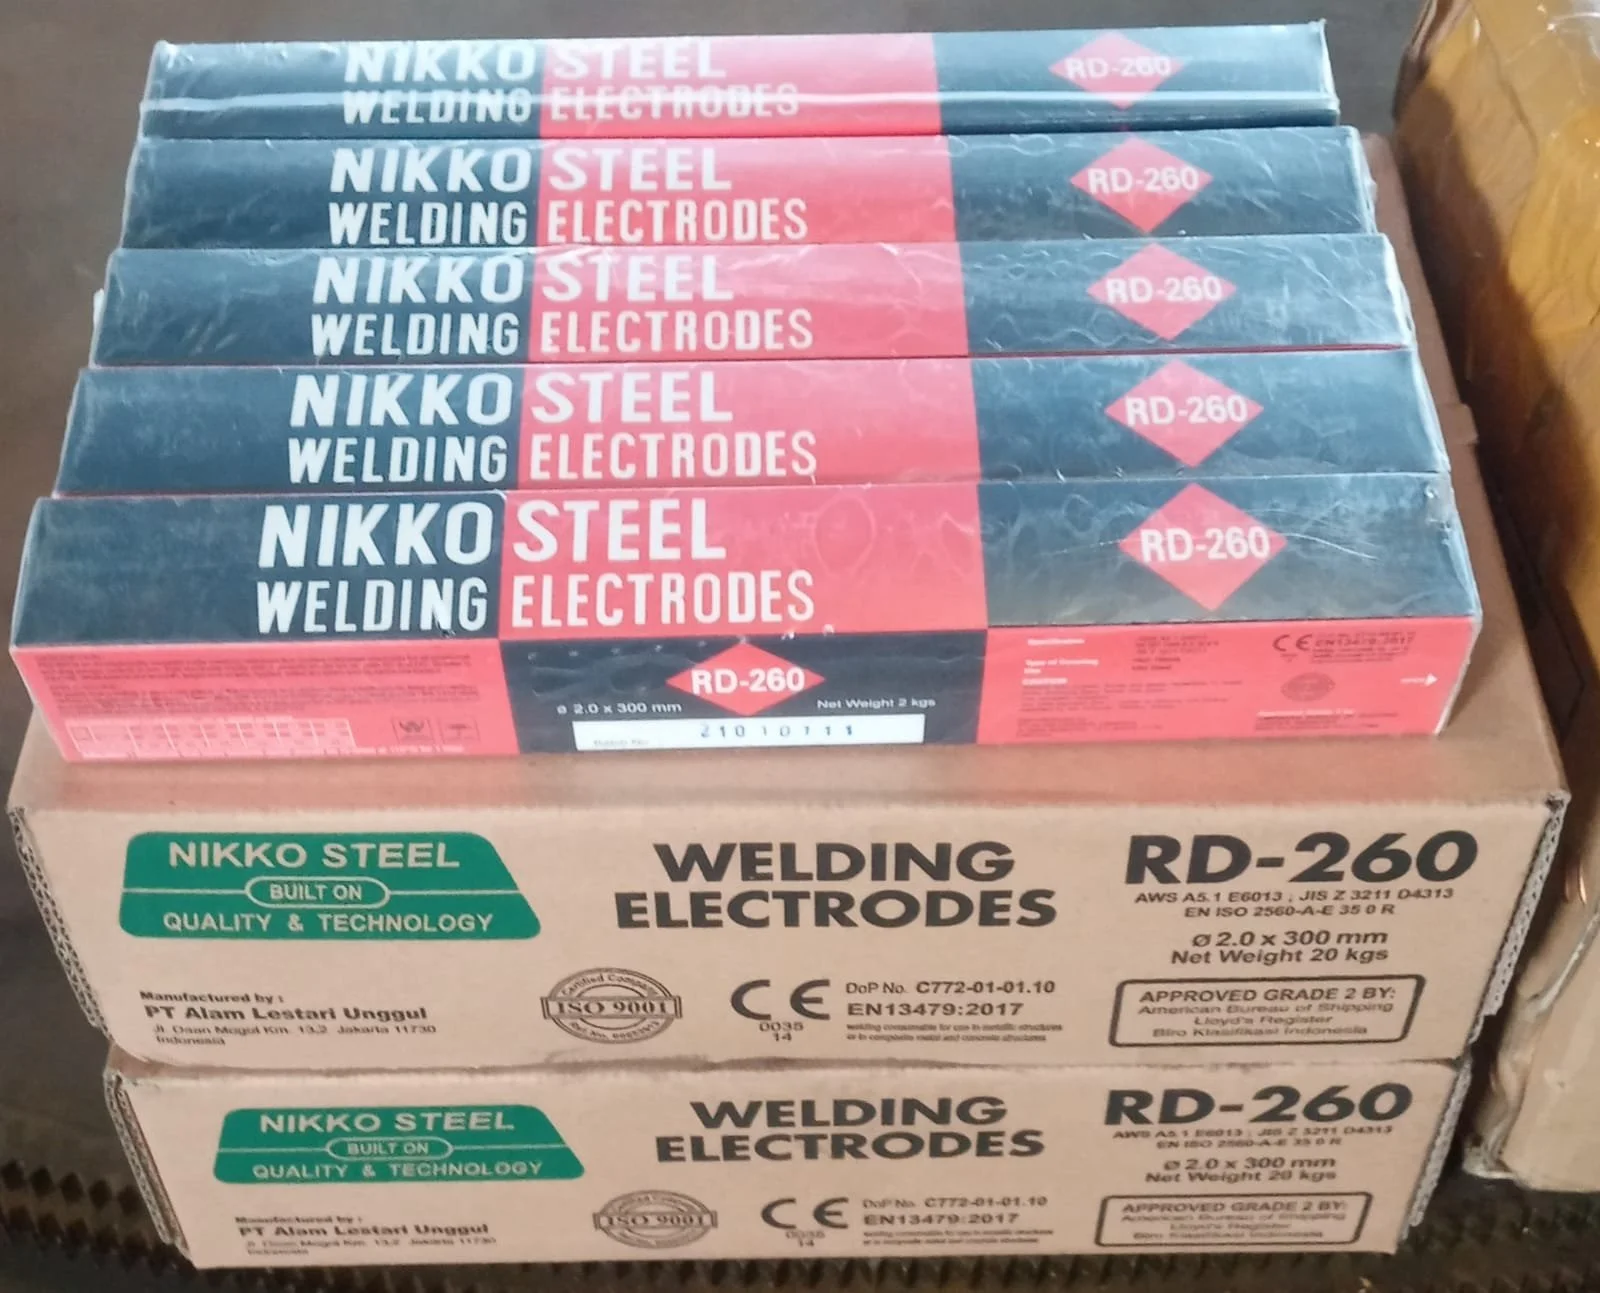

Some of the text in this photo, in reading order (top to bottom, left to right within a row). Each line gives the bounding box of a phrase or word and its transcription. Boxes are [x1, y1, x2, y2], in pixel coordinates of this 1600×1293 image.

[343, 39, 727, 83] NIKKO STEEL
[1064, 55, 1171, 80] RD-260
[342, 83, 800, 126] WELDING ELECTRODES
[329, 146, 733, 194] NIKKO STEEL
[1087, 166, 1199, 194] RD-260
[328, 198, 808, 246] WELDING ELECTRODES
[312, 254, 735, 305] NIKKO STEEL
[1106, 275, 1223, 304] RD-260
[310, 308, 814, 357] WELDING ELECTRODES
[289, 371, 734, 428] NIKKO STEEL
[1125, 394, 1248, 425] RD-260
[288, 431, 817, 484] WELDING ELECTRODES
[257, 498, 727, 568] NIKKO STEEL
[1140, 525, 1271, 562] RD-260
[256, 569, 815, 635] WELDING ELECTRODES
[690, 666, 806, 695] RD-260
[574, 703, 599, 715] 2.0
[617, 702, 647, 714] 300
[652, 703, 682, 714] mm
[817, 697, 937, 710] Net Weight 2 kgs
[168, 841, 460, 869] NIKKO STEEL
[652, 840, 1015, 883] WELDING
[1125, 830, 1479, 885] RD-260
[269, 883, 362, 901] BUILT ON
[1134, 891, 1178, 904] AWS
[1228, 890, 1283, 903] E6013
[1299, 889, 1328, 902] JIS
[1334, 890, 1347, 901] Z
[1351, 888, 1391, 901] 3211
[614, 888, 1058, 930] ELECTRODES
[1184, 906, 1211, 918] EN
[1216, 905, 1248, 918] ISO
[1253, 904, 1334, 918] 2560-A-E
[1381, 903, 1395, 916] R
[163, 912, 494, 933] QUALITY & TECHNOLOGY
[1215, 930, 1255, 948] 2.0
[1261, 933, 1276, 946] x
[1283, 929, 1330, 946] 300
[1336, 931, 1388, 945] mm
[1171, 947, 1389, 967] Net Weight 20 kgs
[139, 990, 251, 1004] Manufactured
[254, 992, 273, 1005] by
[731, 977, 832, 1022] CE
[845, 982, 879, 994] DoP
[916, 980, 1056, 995] C772-01-01.10
[1138, 986, 1396, 1003] APPROVED GRADE 2 BY:
[144, 1004, 428, 1023] PT Alam Lestari Unggul
[558, 1001, 666, 1014] ISO 9001
[847, 1002, 1024, 1017] EN13479:2017
[1137, 1004, 1222, 1015] American
[1226, 1004, 1290, 1014] Bureau
[1317, 1001, 1394, 1015] Shipping
[690, 1095, 1009, 1130] WELDING
[1103, 1082, 1414, 1126] RD-260
[259, 1111, 516, 1134] NIKKO STEEL
[347, 1141, 430, 1156] BUILT ON
[655, 1129, 1046, 1164] ELECTRODES
[252, 1160, 543, 1180] QUALITY & TECHNOLOGY
[1224, 1159, 1238, 1170] x
[1244, 1156, 1285, 1170] 300
[1290, 1156, 1337, 1169] mm
[1145, 1171, 1181, 1184] Net
[1188, 1170, 1261, 1185] Weight
[1299, 1169, 1337, 1183] kgs
[760, 1196, 850, 1230] CE
[863, 1212, 1020, 1226] EN13479:2017
[1122, 1201, 1225, 1214] APPROVED
[238, 1226, 265, 1237] PT
[274, 1225, 329, 1237] Alam
[414, 1223, 489, 1237] Unggul
